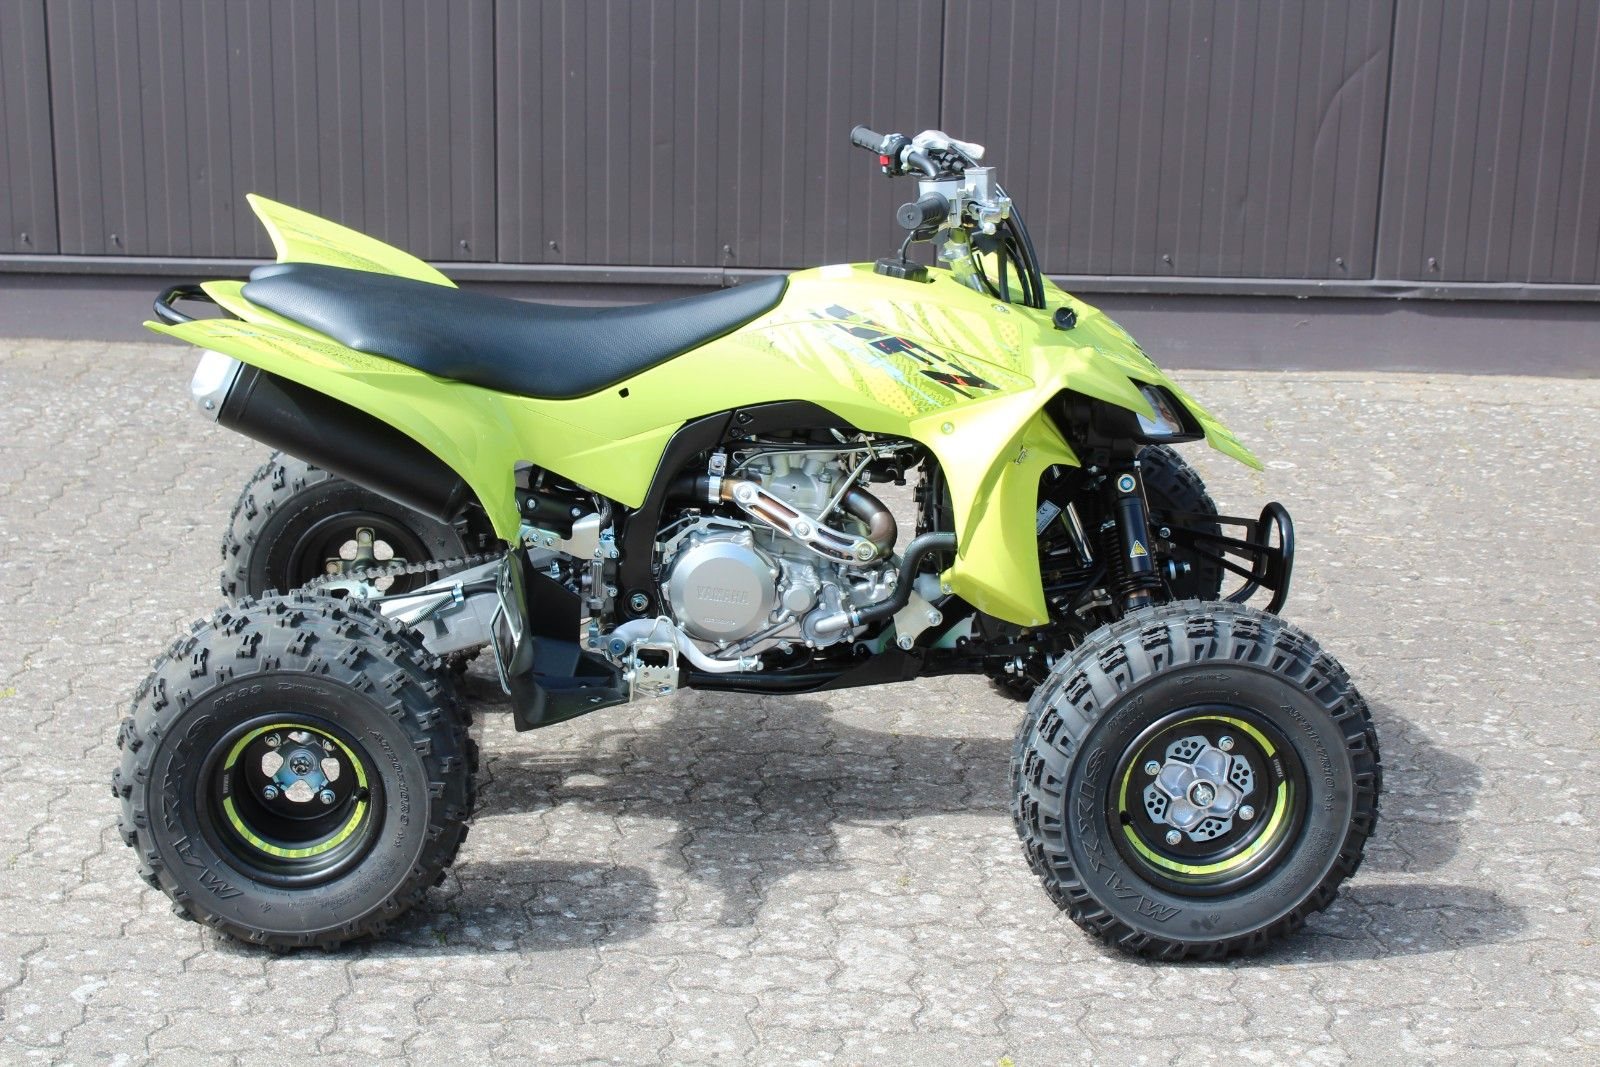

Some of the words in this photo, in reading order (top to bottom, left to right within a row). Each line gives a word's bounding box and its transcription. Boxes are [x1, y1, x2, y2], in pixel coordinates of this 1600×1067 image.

[697, 586, 750, 605] YAMAHA
[163, 714, 243, 900] MAXXIS
[1077, 749, 1182, 922] MAXXIS
